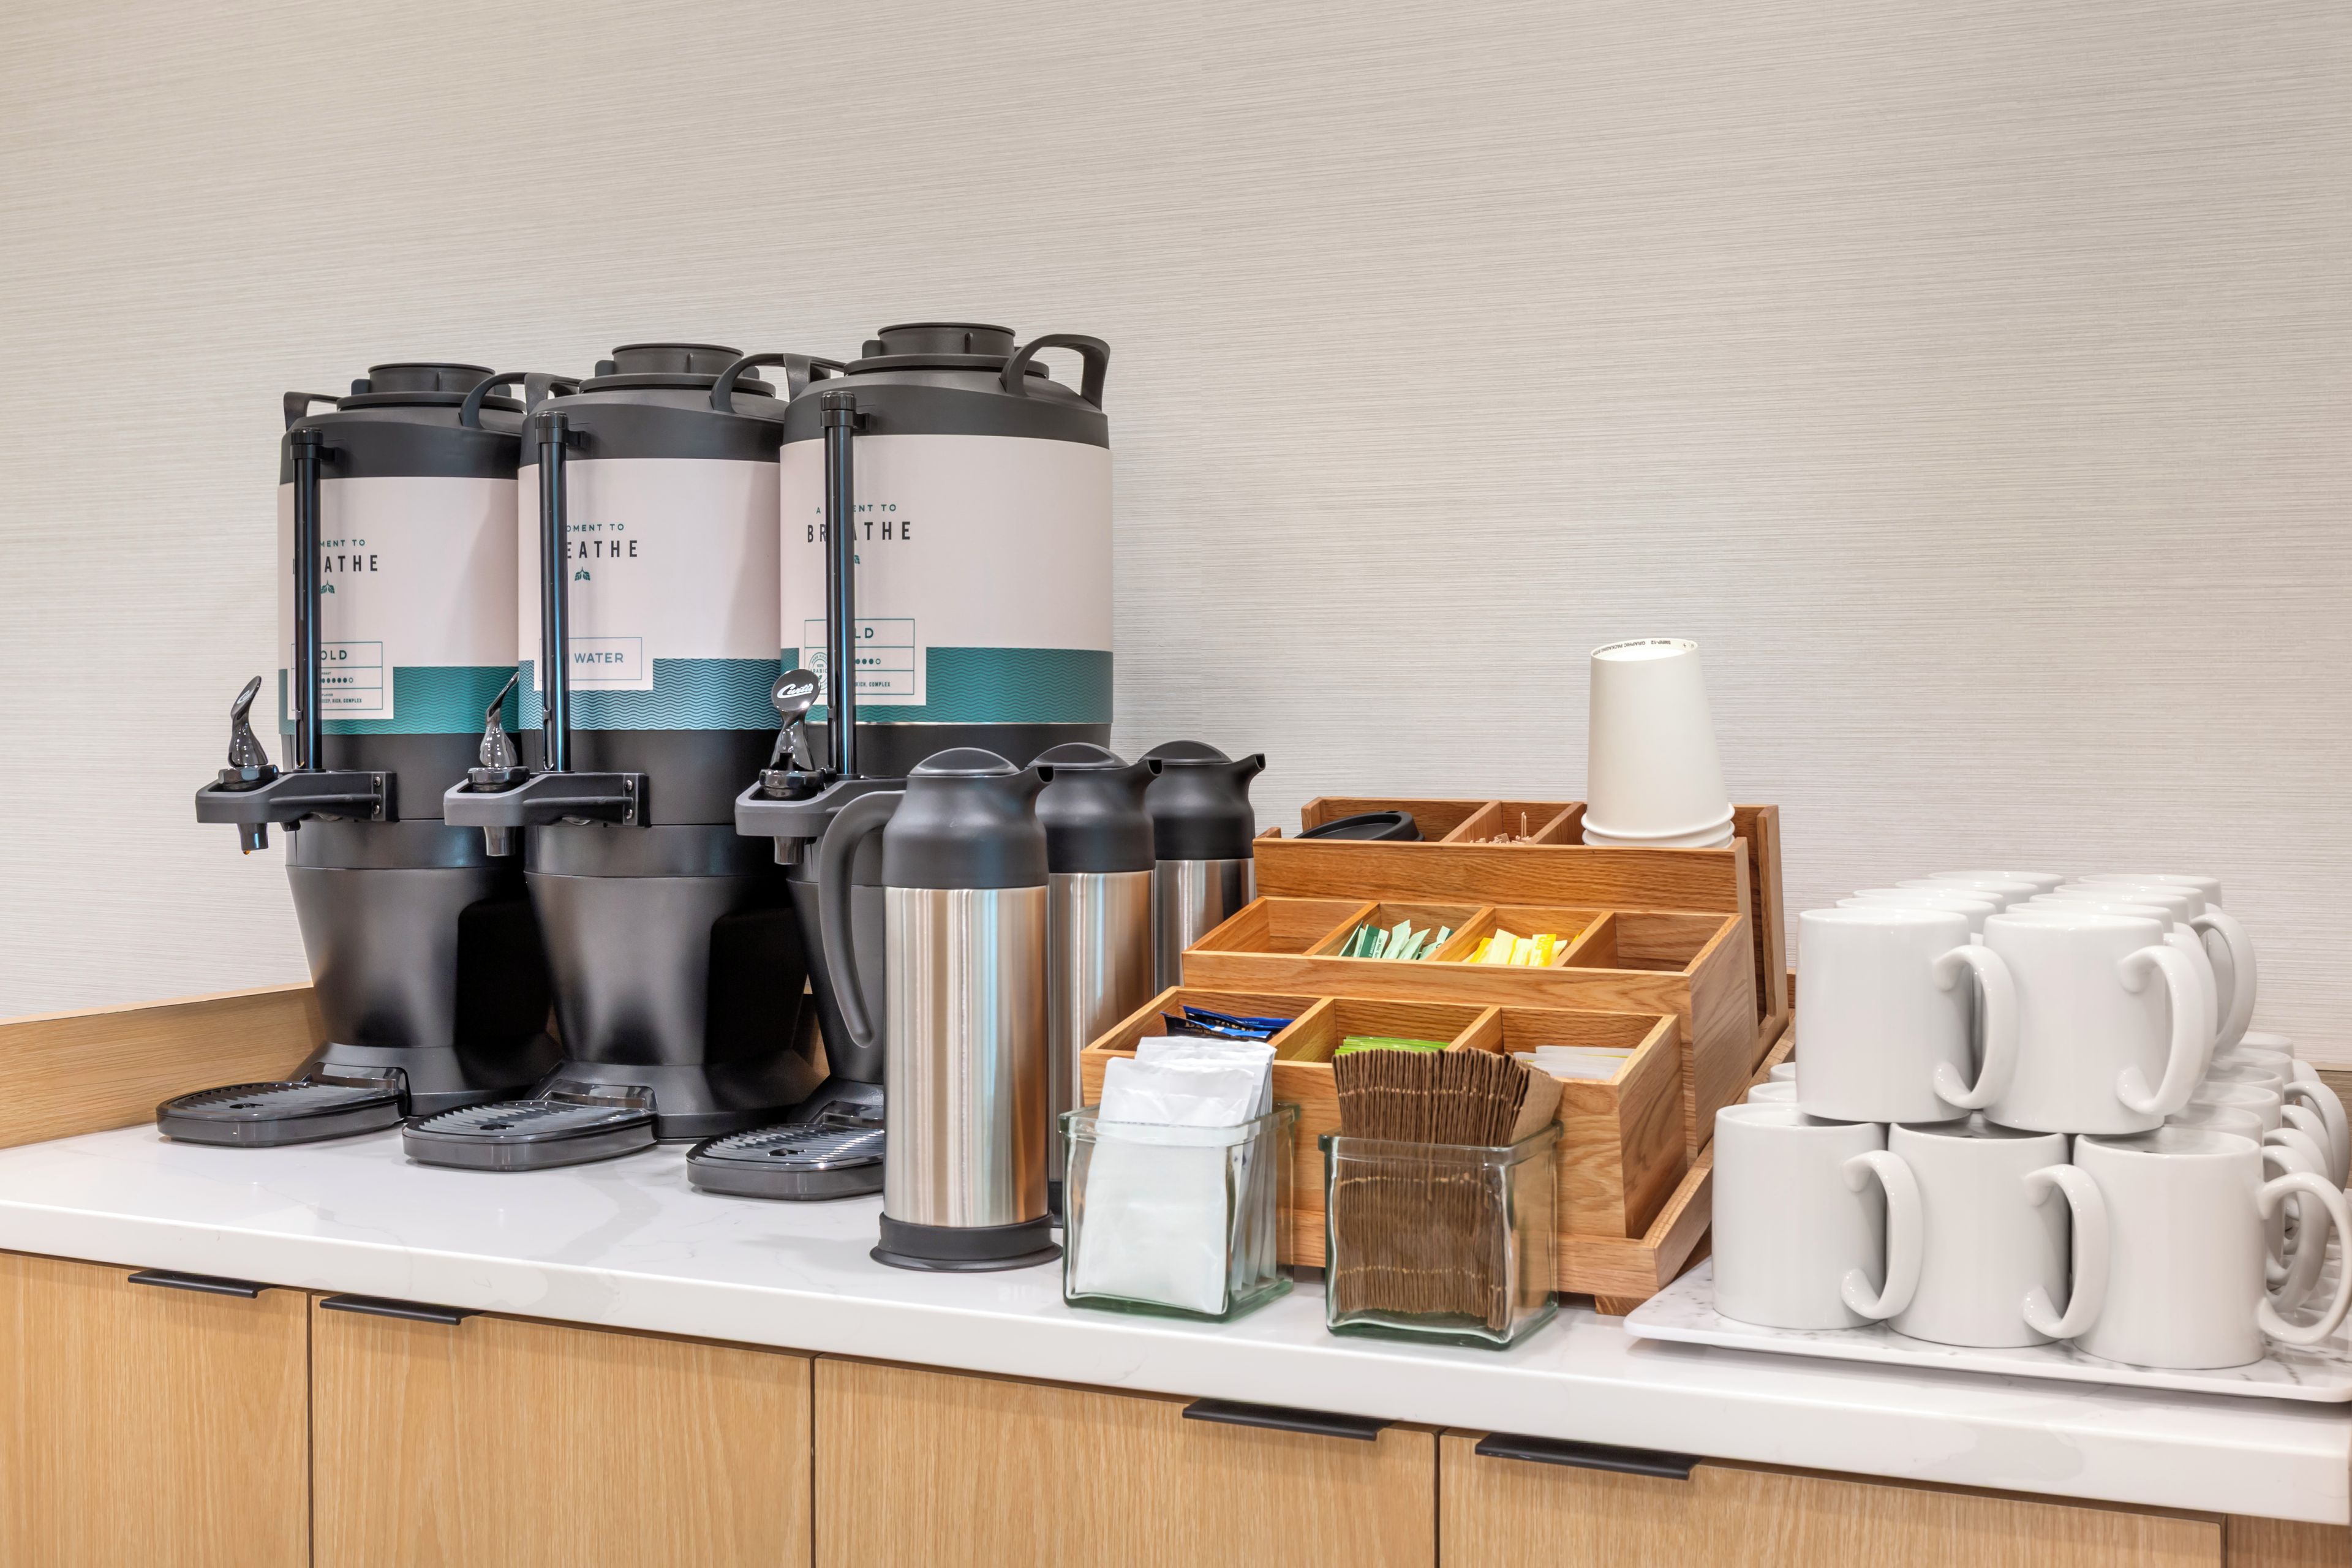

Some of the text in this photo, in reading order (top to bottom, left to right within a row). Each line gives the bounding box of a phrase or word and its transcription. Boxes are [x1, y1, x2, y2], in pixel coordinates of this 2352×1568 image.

[567, 524, 602, 532] OMENT
[807, 521, 911, 543] BRTHE
[320, 540, 345, 548] MENT
[567, 540, 638, 559] EATHE
[854, 627, 874, 638] LD
[1600, 644, 1623, 652] PACKAGING
[320, 649, 348, 661] OLD
[573, 652, 624, 663] WATER
